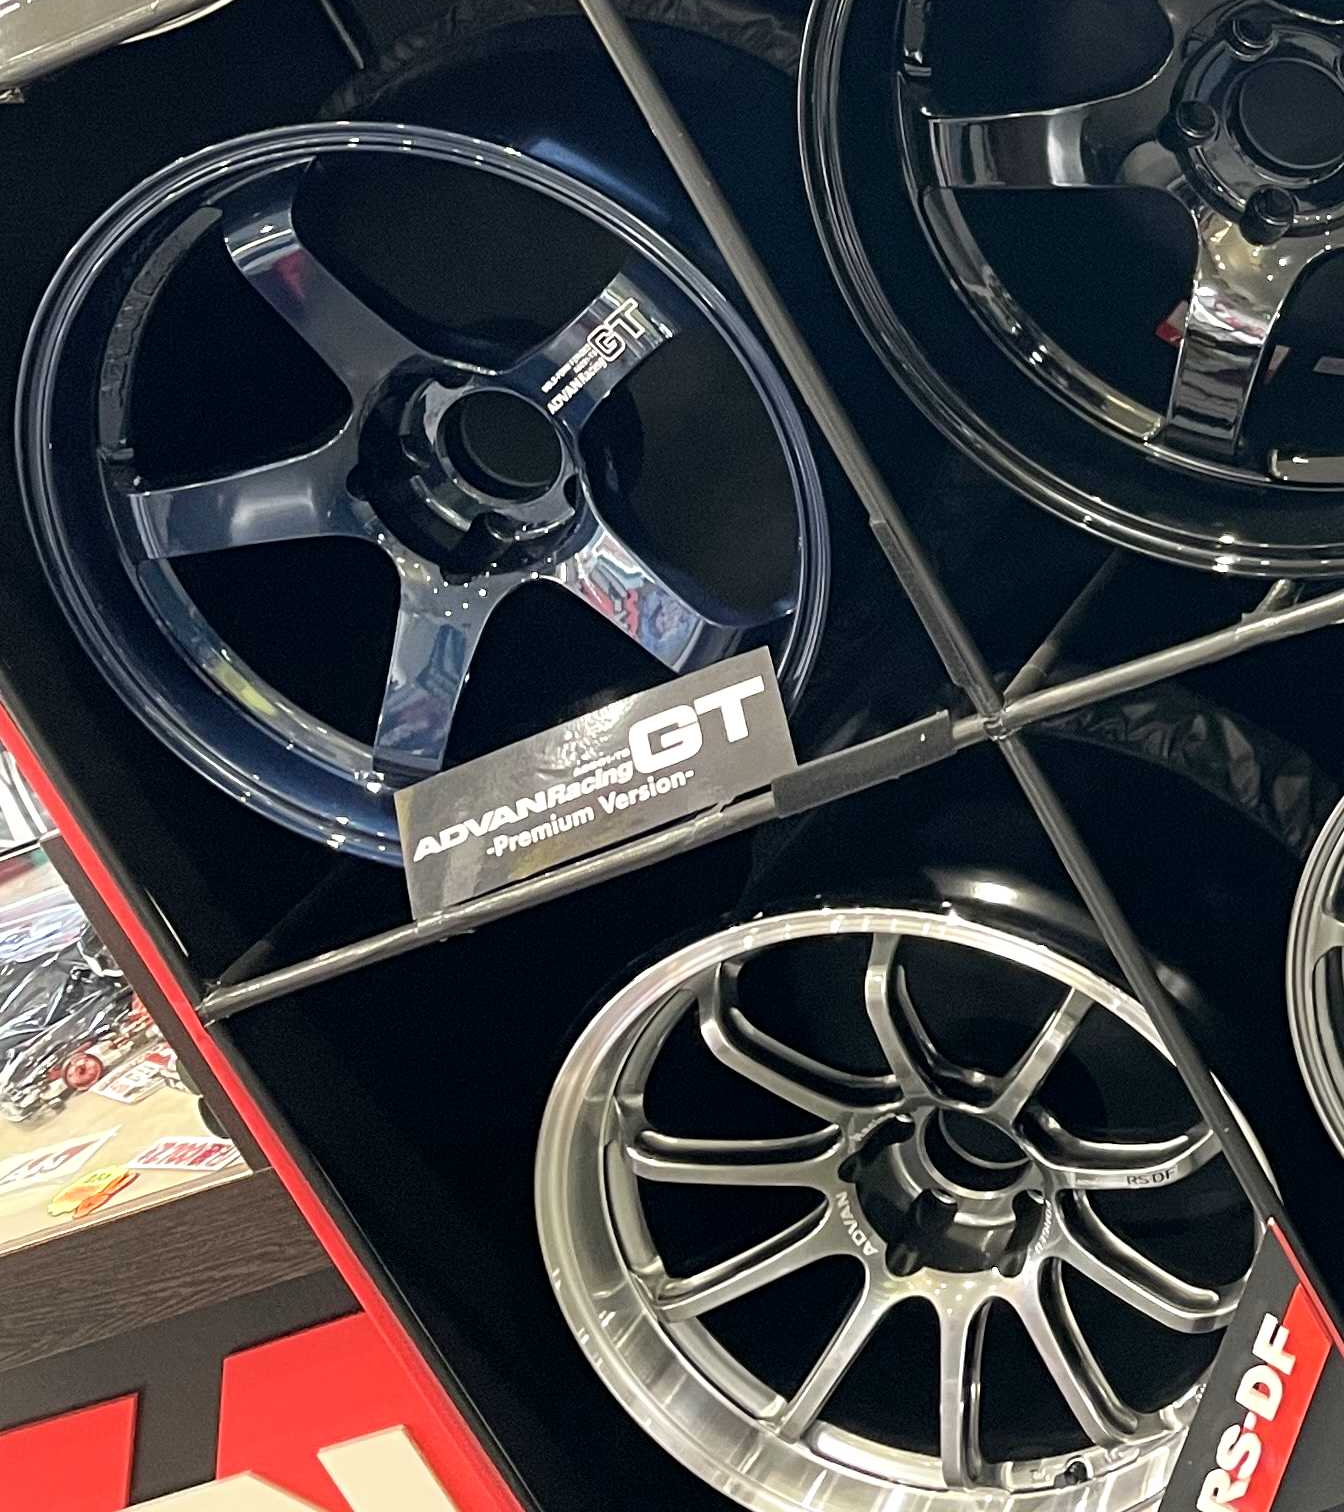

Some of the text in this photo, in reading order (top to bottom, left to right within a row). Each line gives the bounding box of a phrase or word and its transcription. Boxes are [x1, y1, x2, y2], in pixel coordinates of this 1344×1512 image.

[628, 675, 765, 774] GT
[836, 1192, 878, 1256] ADVAN
[1196, 1312, 1297, 1512] RS-DF
